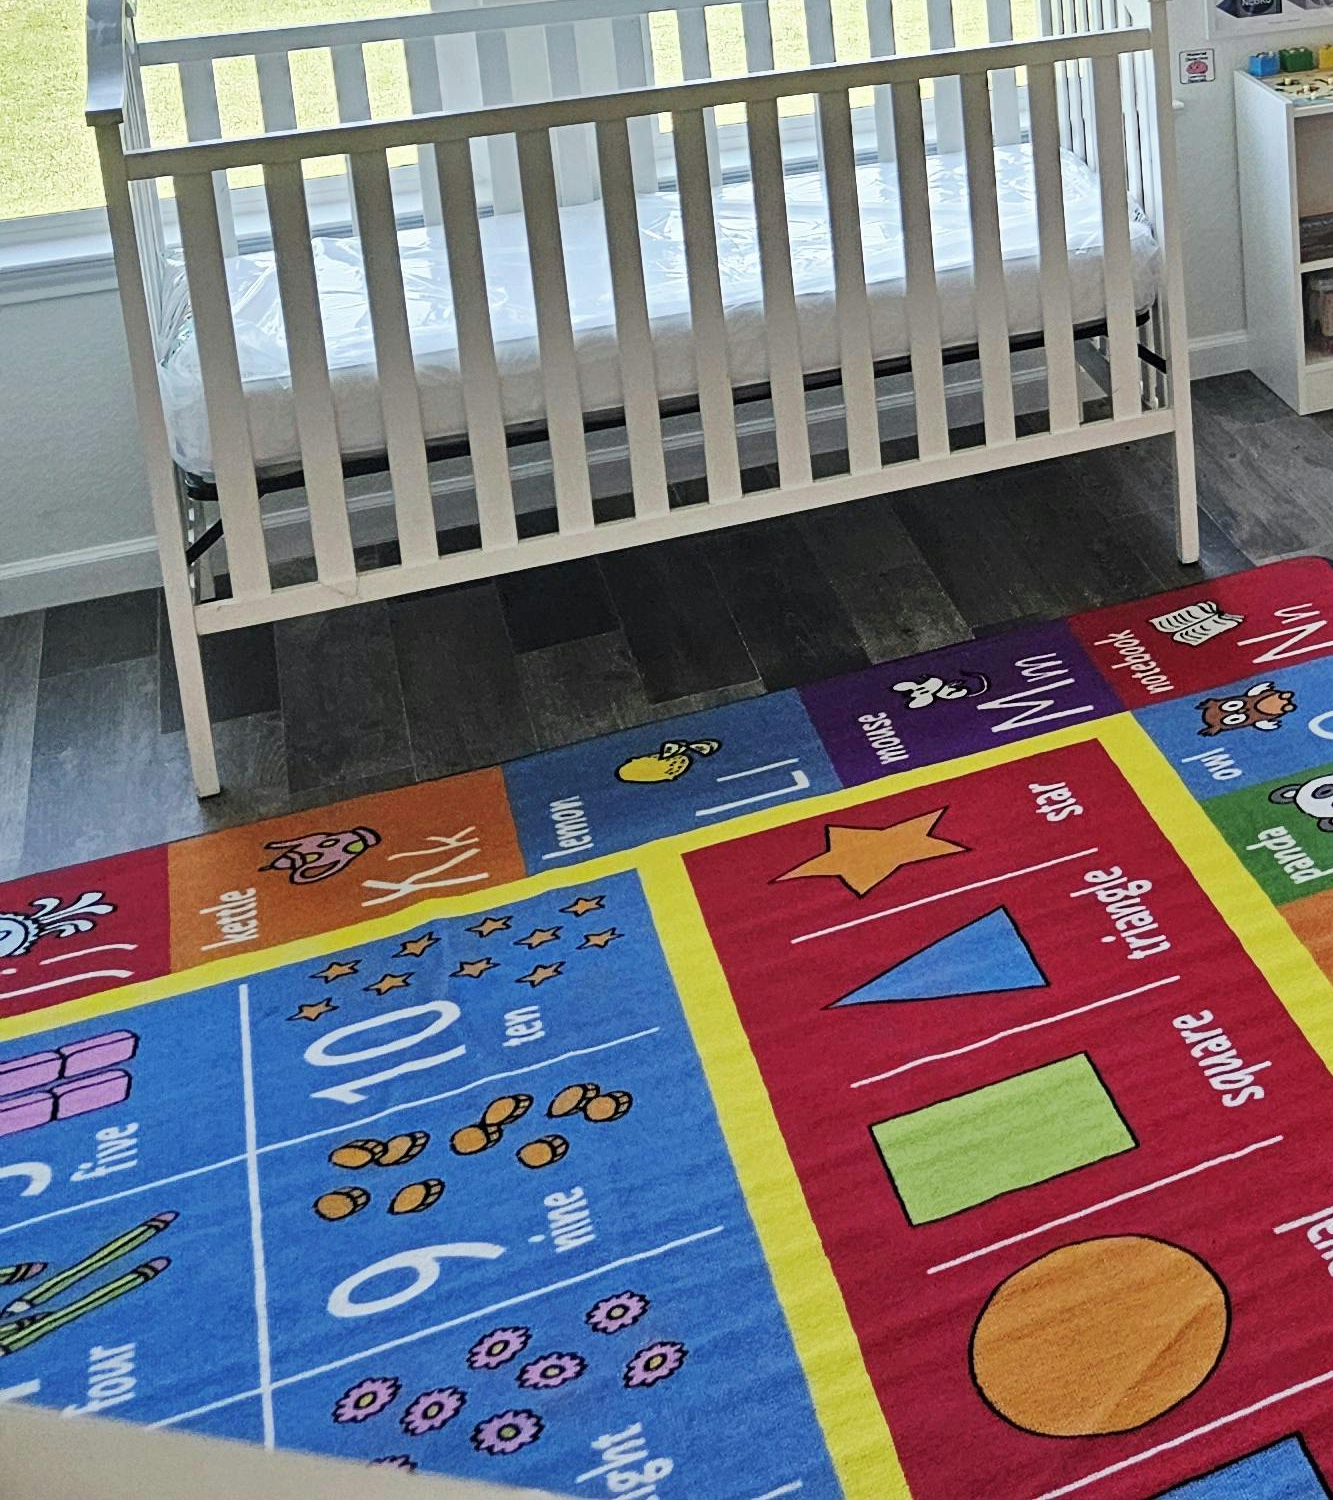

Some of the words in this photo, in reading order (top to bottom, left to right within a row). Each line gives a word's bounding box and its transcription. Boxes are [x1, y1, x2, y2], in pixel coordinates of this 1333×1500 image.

[1095, 629, 1177, 694] notebook
[858, 713, 909, 764] mouse
[1182, 748, 1242, 780] owl
[542, 796, 582, 860] lemon
[1029, 782, 1083, 821] star
[200, 888, 258, 950] kettle
[1070, 866, 1170, 959] triangle
[304, 1000, 466, 1104] 10
[503, 1006, 545, 1046] ten
[1173, 1010, 1271, 1107] square
[71, 1123, 138, 1181] five
[530, 1187, 583, 1252] nine
[327, 1242, 506, 1317] 9
[62, 1342, 136, 1417] four
